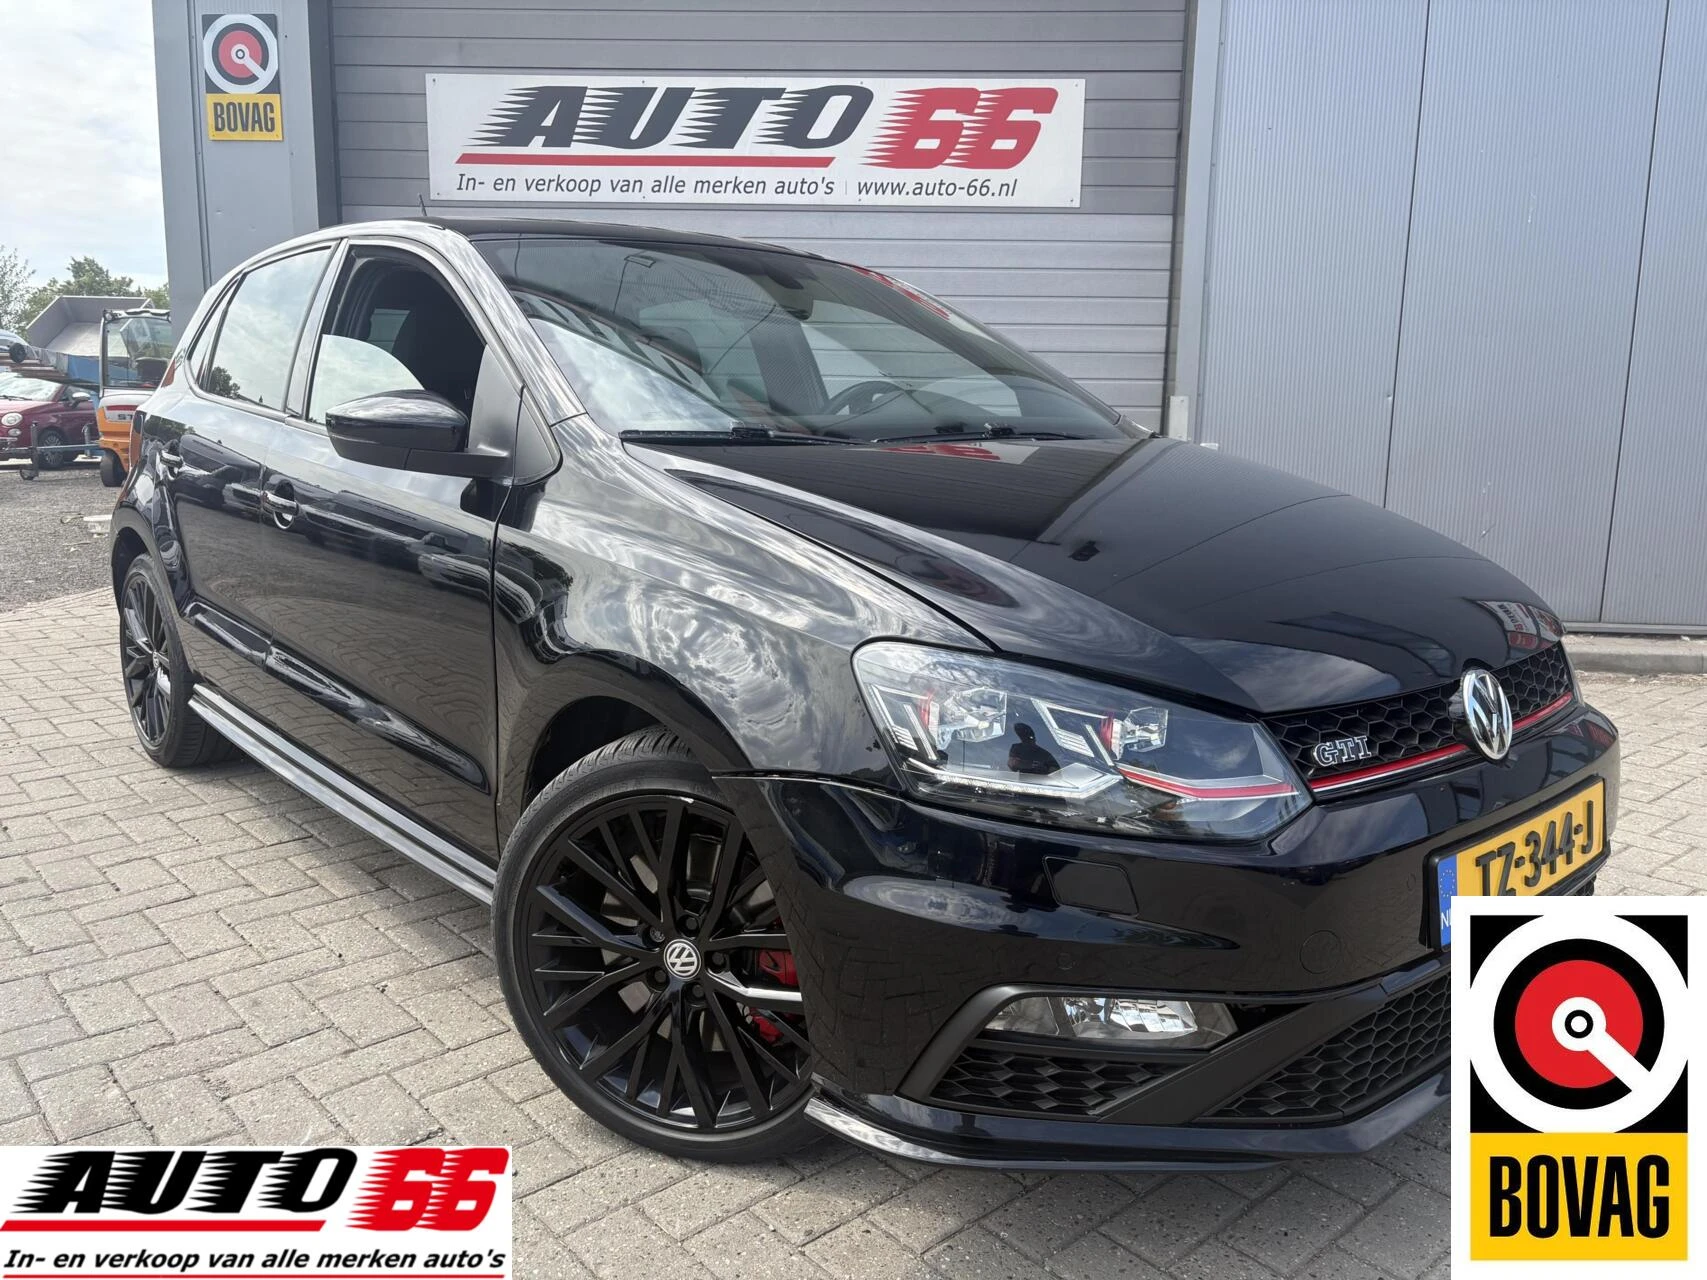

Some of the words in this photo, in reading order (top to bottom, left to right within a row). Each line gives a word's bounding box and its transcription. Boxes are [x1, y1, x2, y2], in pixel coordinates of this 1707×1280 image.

[213, 101, 275, 133] BOVAG
[463, 85, 874, 149] AUTO
[858, 87, 1058, 169] 66
[456, 173, 485, 191] In-
[493, 177, 516, 192] en
[525, 174, 602, 197] verkoop
[610, 179, 643, 193] van
[651, 175, 686, 194] alle
[693, 175, 766, 194] merken
[774, 176, 835, 195] auto's
[857, 177, 1018, 198] www.auto-66.nl
[1313, 735, 1372, 767] GTI
[1475, 799, 1595, 896] TZ-344-J
